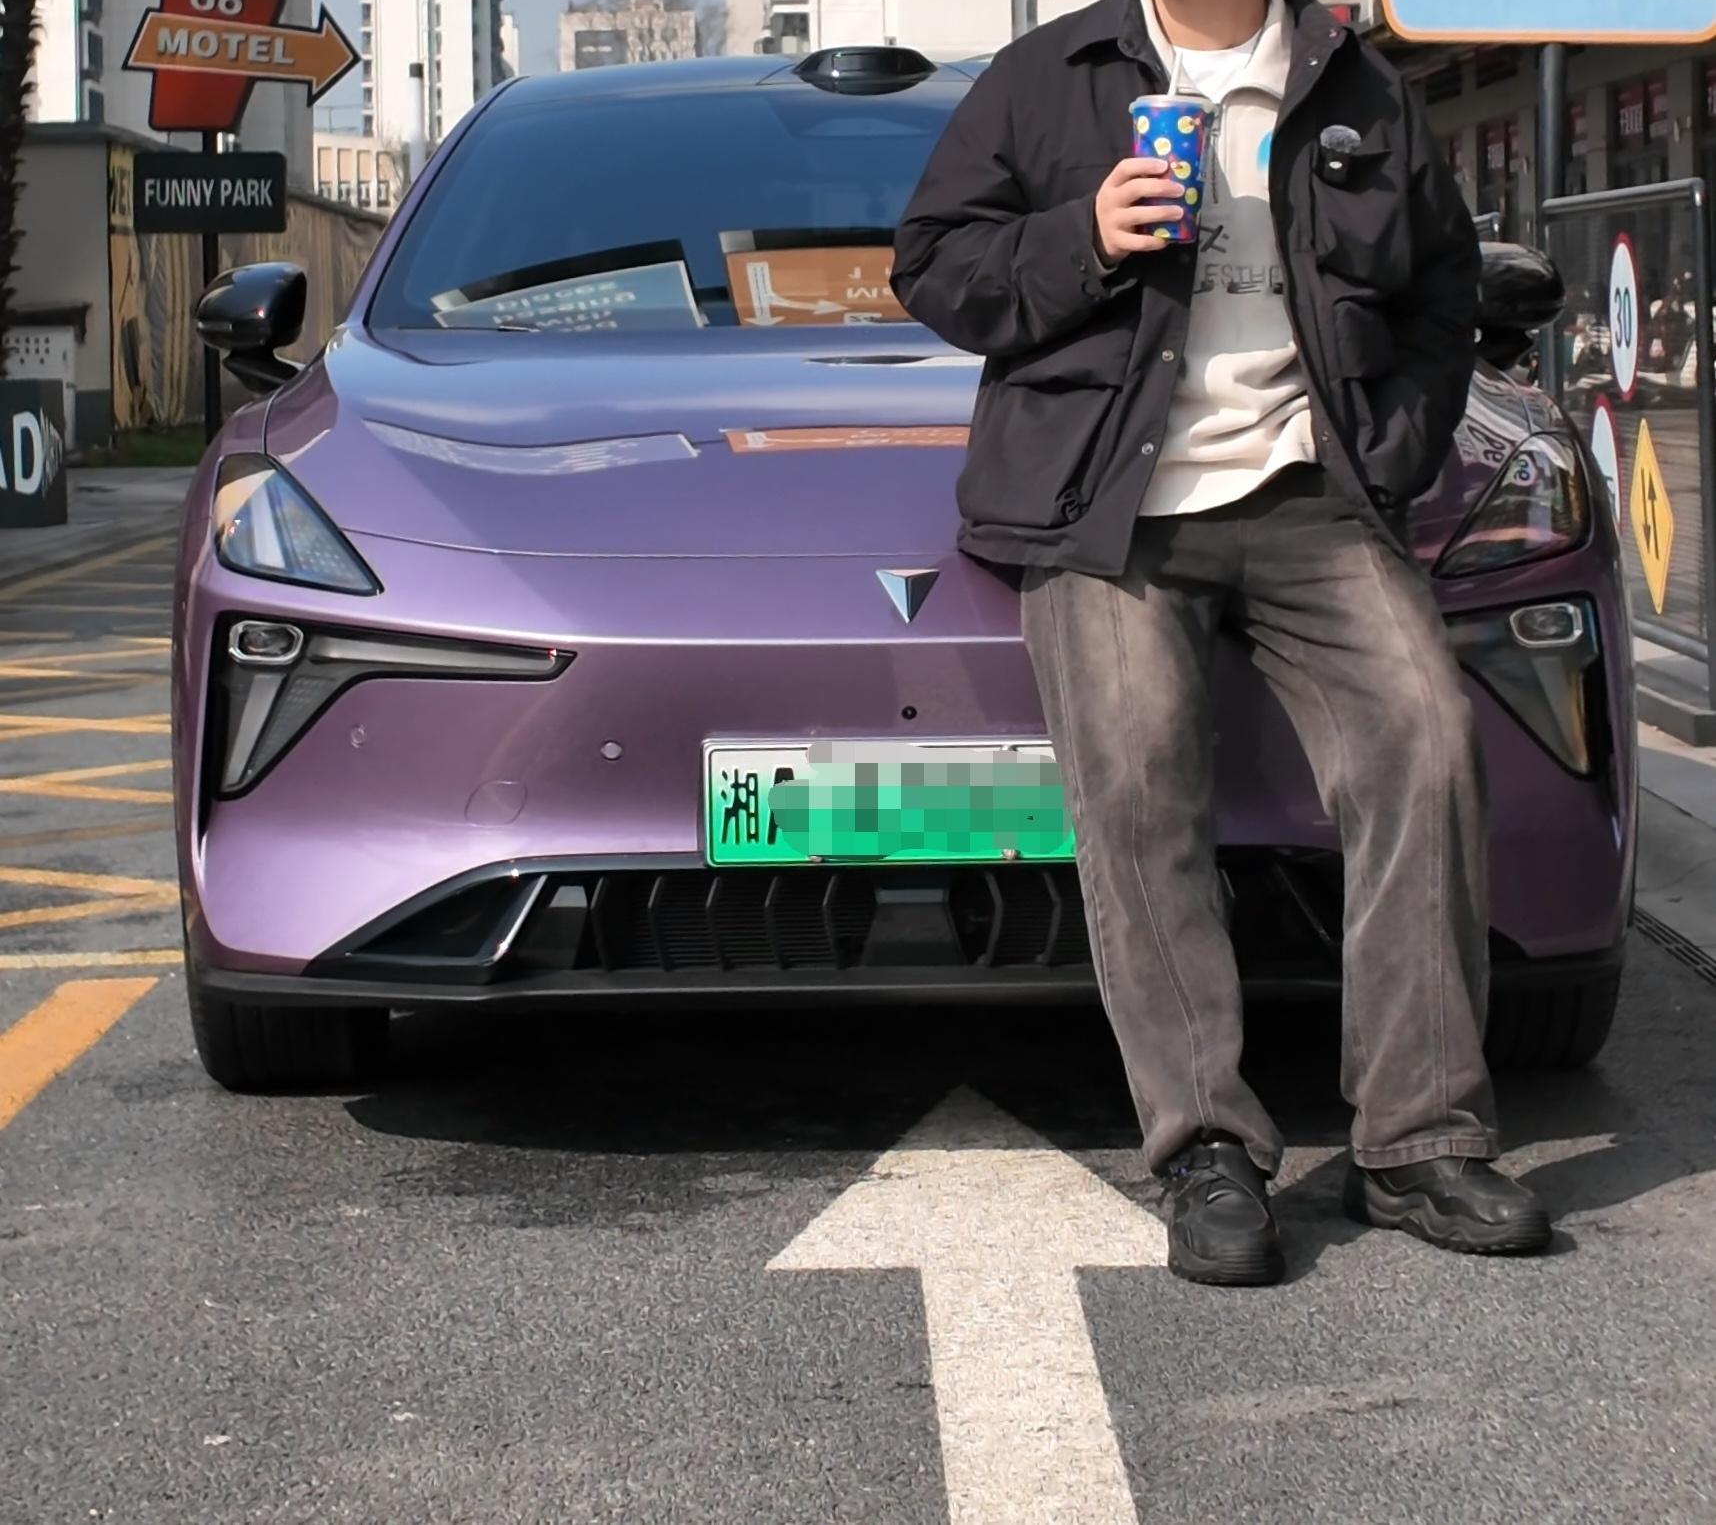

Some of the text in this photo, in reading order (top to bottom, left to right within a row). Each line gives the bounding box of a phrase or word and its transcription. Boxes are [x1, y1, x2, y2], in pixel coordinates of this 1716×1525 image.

[156, 26, 296, 66] MOTEL
[144, 178, 215, 207] FUNNY
[220, 178, 273, 207] PARK
[1614, 286, 1632, 349] 30
